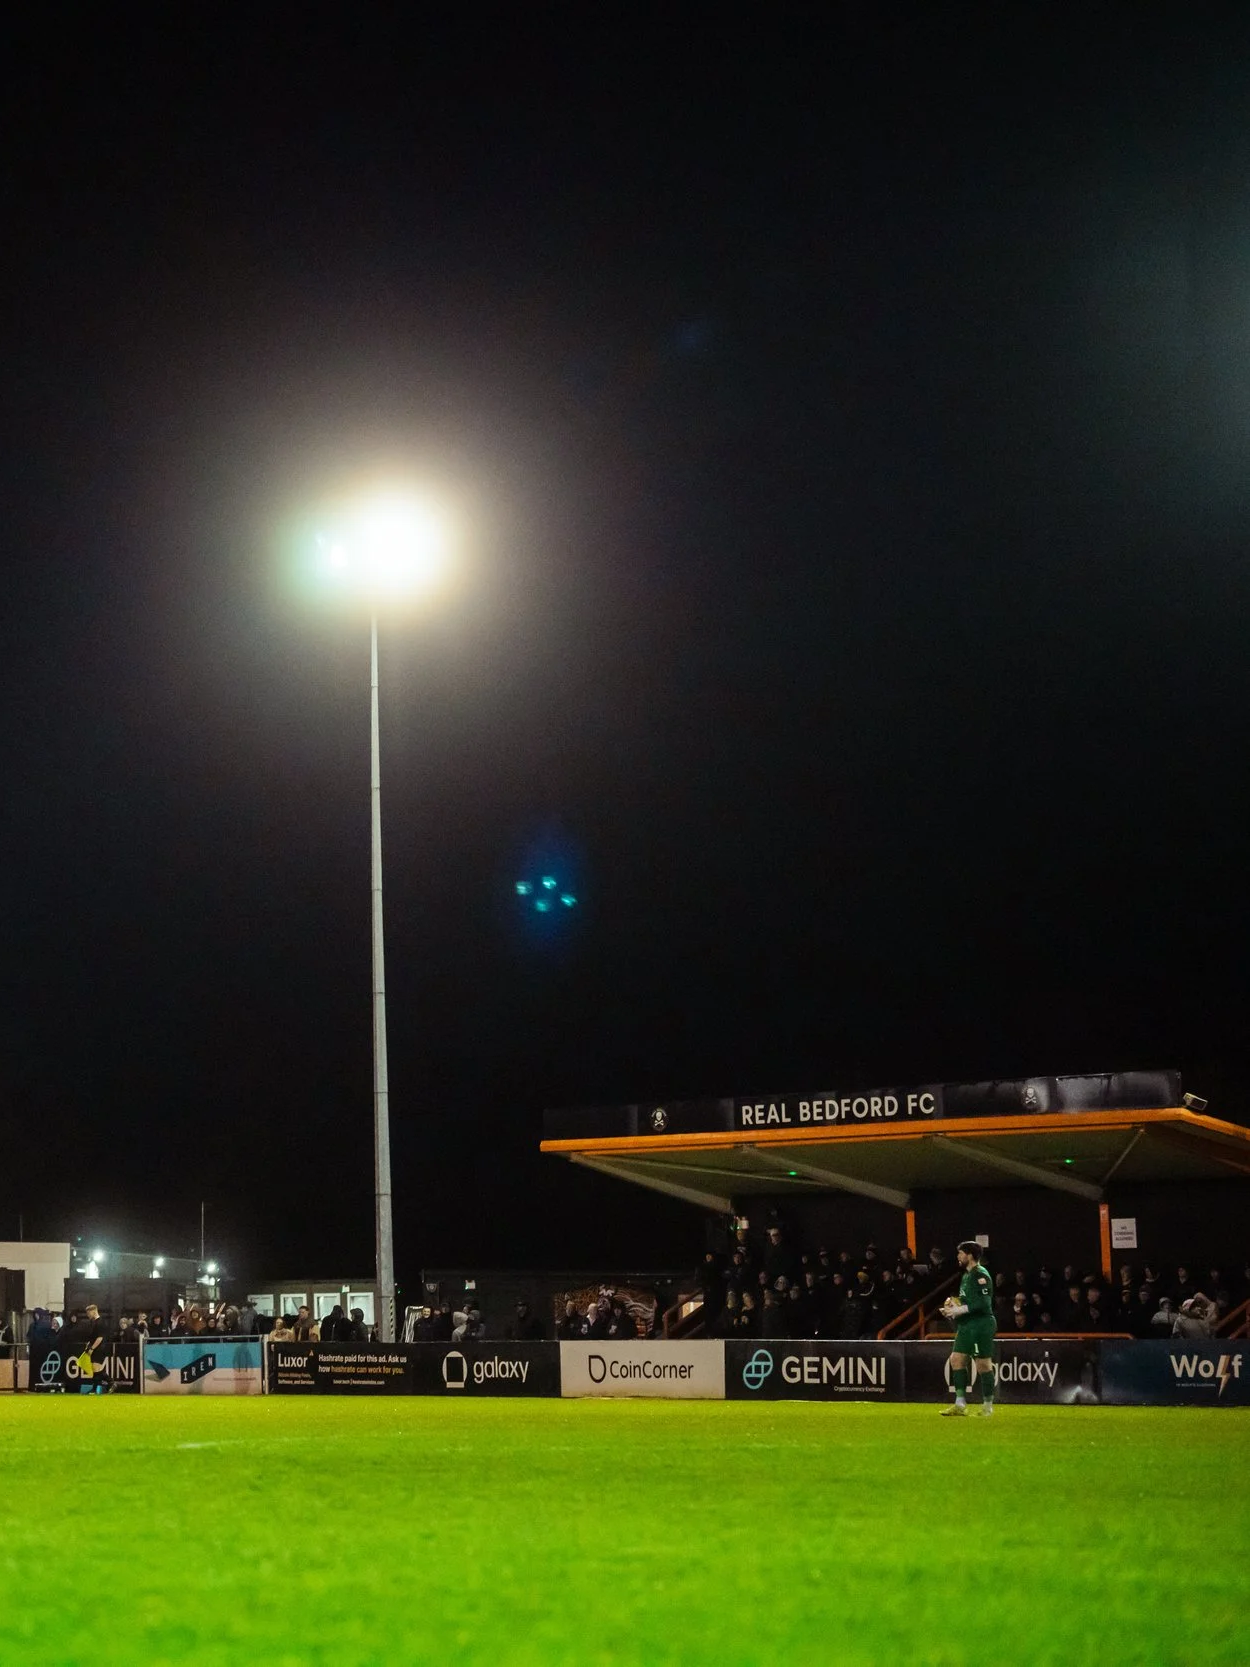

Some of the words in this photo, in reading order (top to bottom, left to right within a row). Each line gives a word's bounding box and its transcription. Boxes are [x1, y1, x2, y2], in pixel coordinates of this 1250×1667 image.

[741, 1103, 792, 1126] REAL
[800, 1096, 898, 1121] BEDFORD
[907, 1093, 935, 1115] FC
[981, 1287, 989, 1295] C
[973, 1343, 979, 1354] 1
[278, 1353, 308, 1368] Luxor
[318, 1354, 344, 1362] Hashrate
[344, 1354, 357, 1364] paid
[357, 1354, 367, 1362] for
[367, 1354, 378, 1363] this
[378, 1355, 387, 1363] ad.
[388, 1354, 399, 1363] Ask
[183, 1357, 213, 1381] IREN
[318, 1365, 330, 1373] how
[331, 1365, 355, 1373] hashrate
[367, 1366, 382, 1374] work
[382, 1366, 392, 1374] for
[392, 1367, 405, 1375] you.
[473, 1355, 529, 1384] galaxy
[610, 1360, 694, 1379] CoinCorner
[781, 1355, 886, 1385] GEMINI
